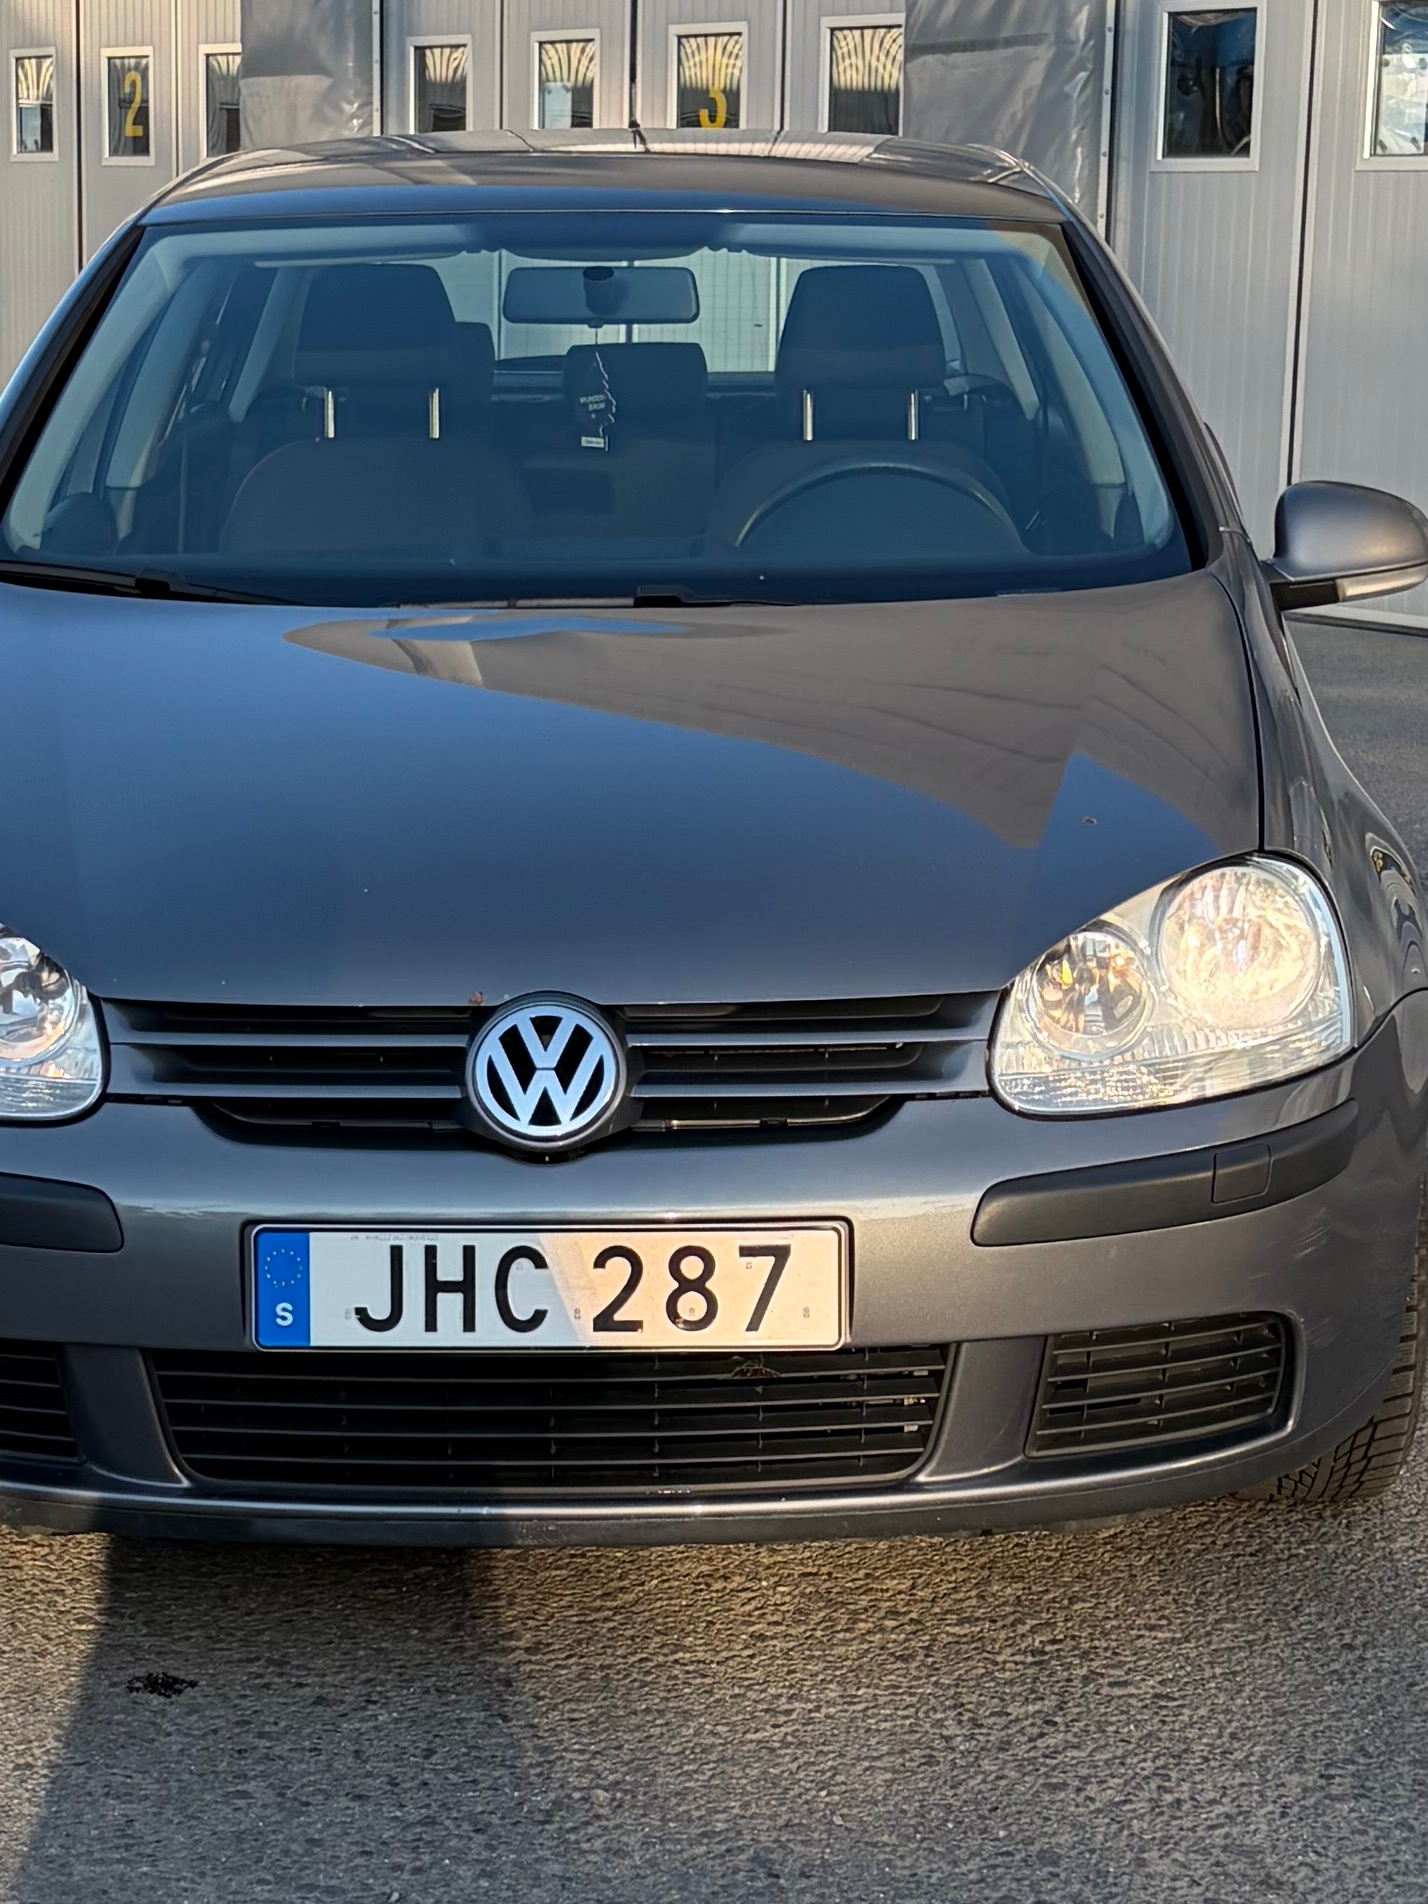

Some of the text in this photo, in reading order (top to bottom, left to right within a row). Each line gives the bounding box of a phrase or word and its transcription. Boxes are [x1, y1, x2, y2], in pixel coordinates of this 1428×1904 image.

[124, 70, 144, 138] 2
[480, 1008, 612, 1132] VW
[275, 1302, 294, 1328] S
[354, 1243, 792, 1333] JHC 287
